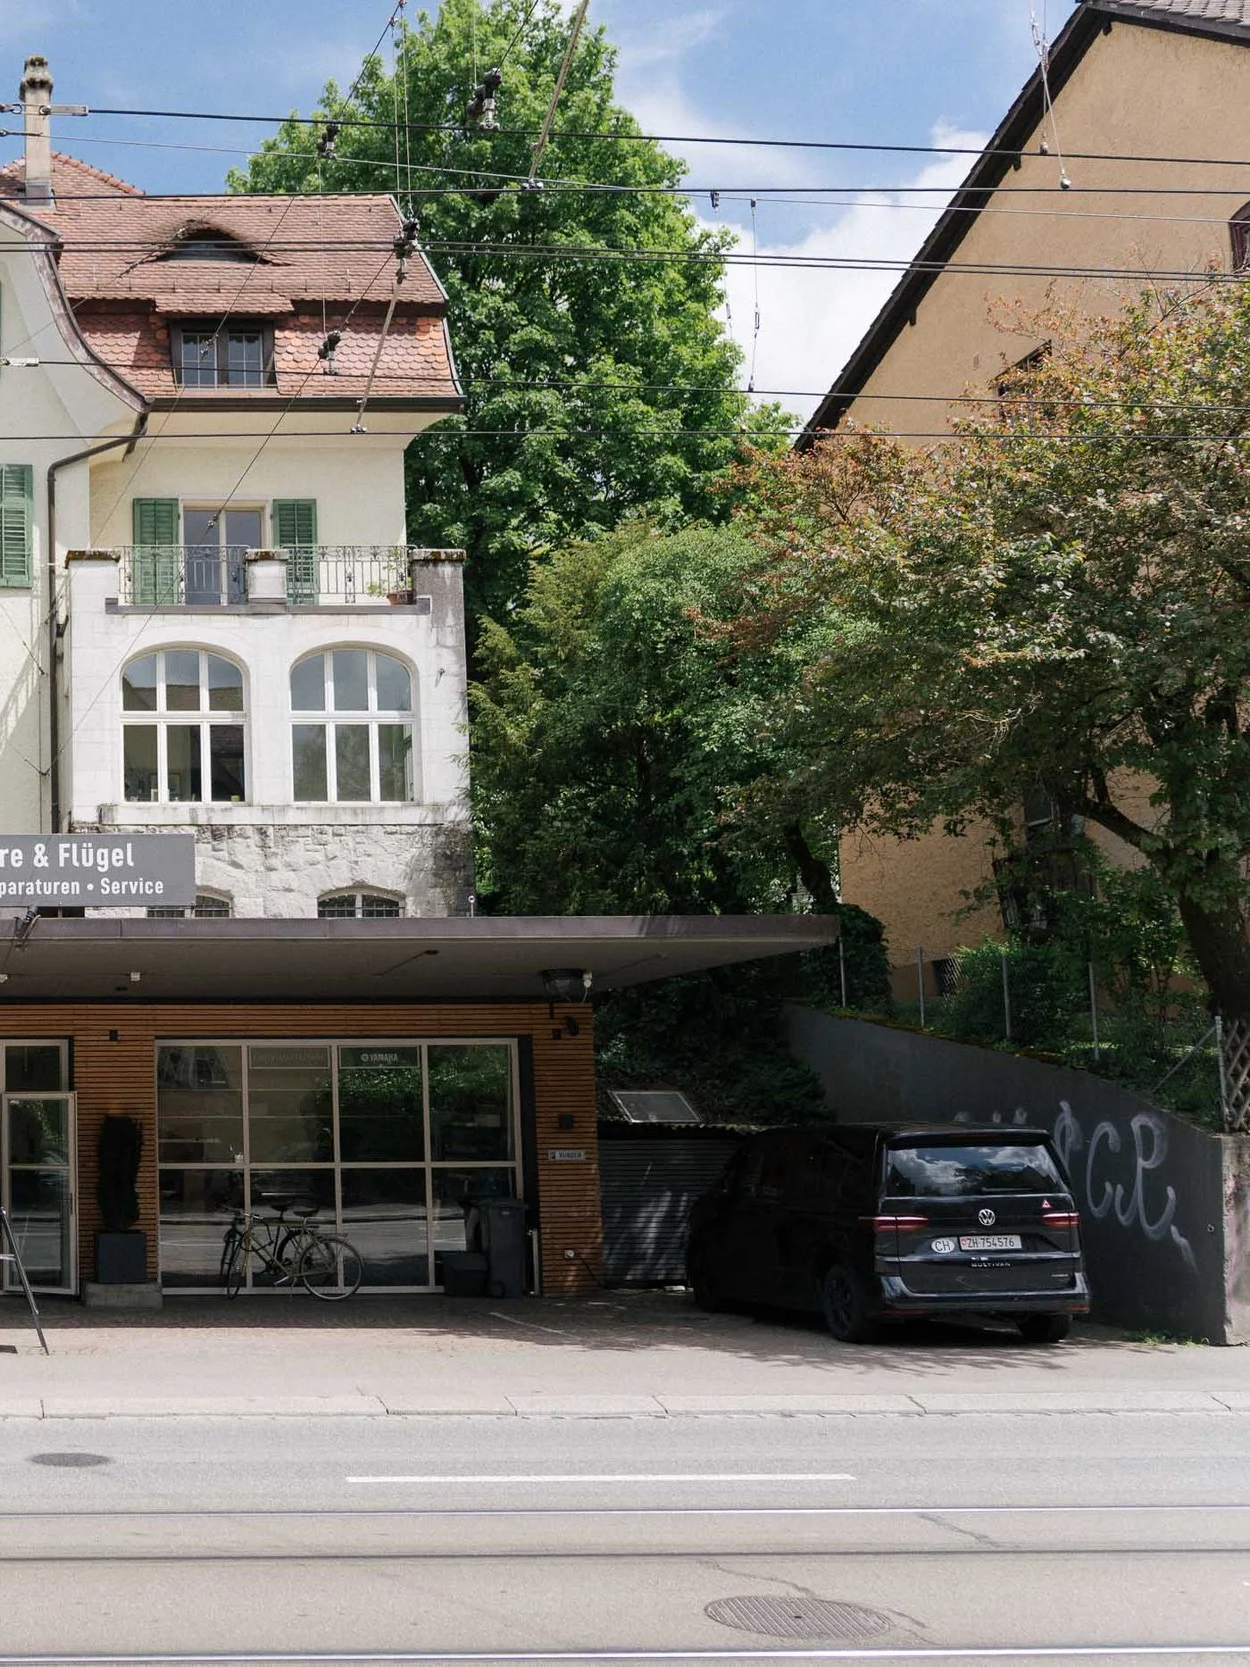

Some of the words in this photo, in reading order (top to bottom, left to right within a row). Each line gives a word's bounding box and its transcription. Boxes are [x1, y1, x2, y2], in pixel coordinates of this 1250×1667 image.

[33, 843, 49, 868] &
[58, 842, 135, 872] Flügel
[100, 877, 164, 895] Service
[369, 1053, 399, 1063] YAMAHA
[934, 1240, 951, 1252] CH
